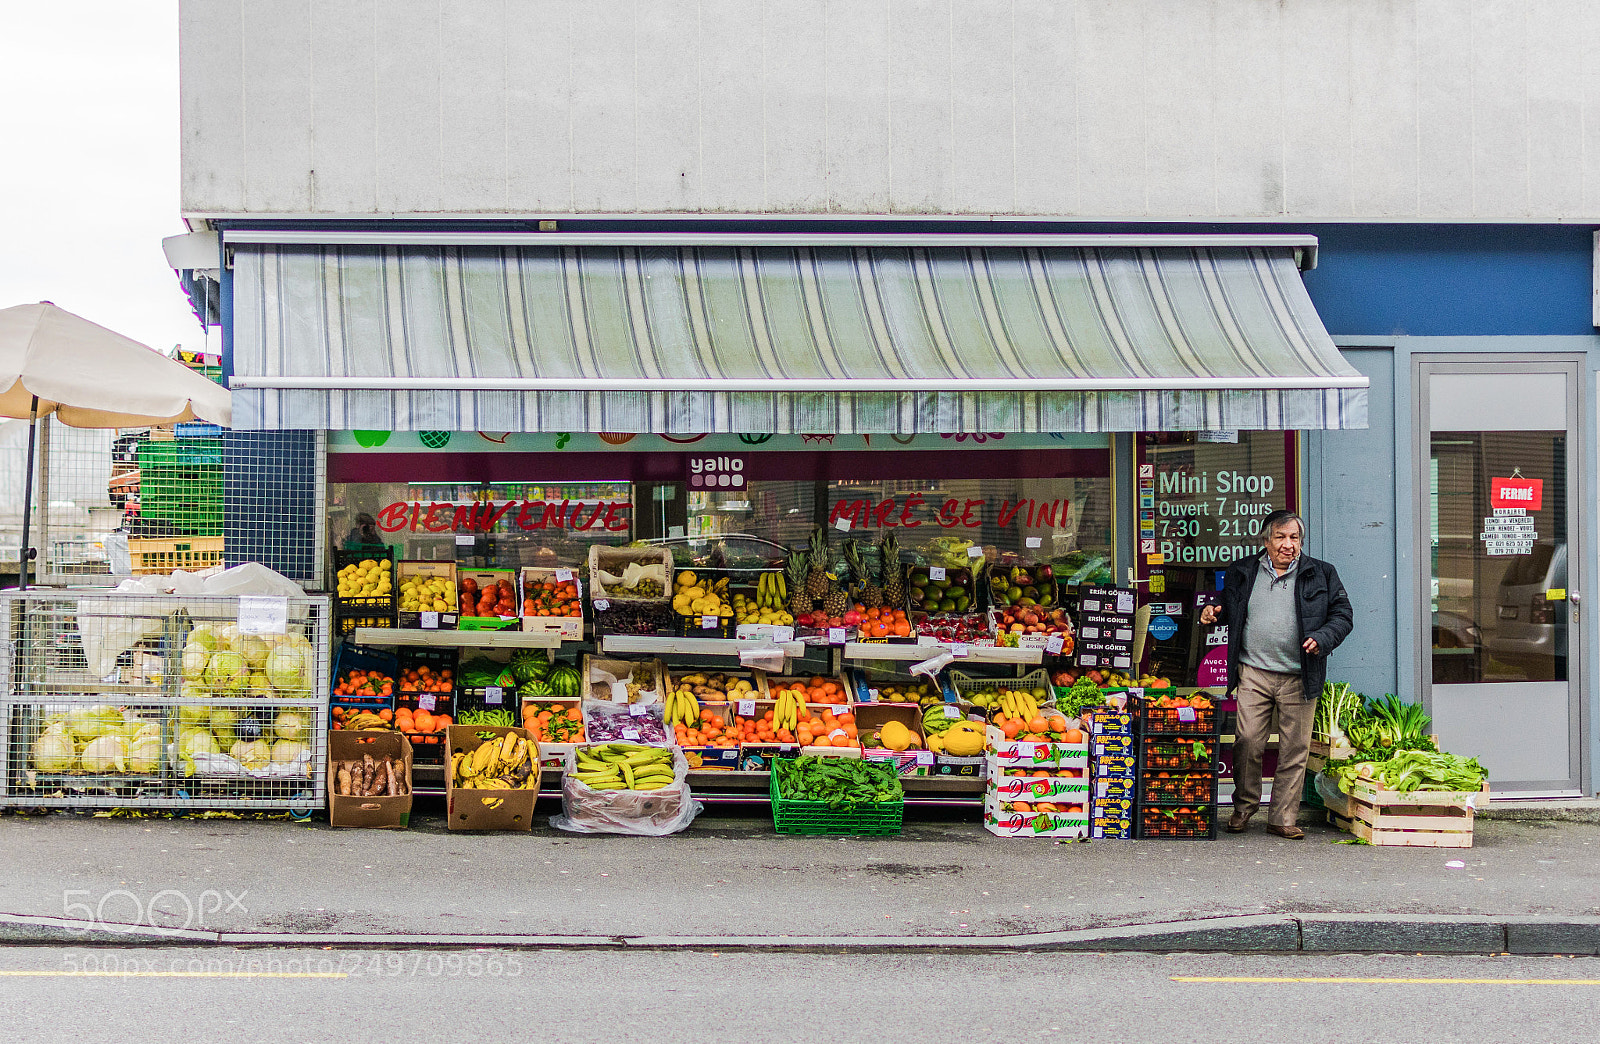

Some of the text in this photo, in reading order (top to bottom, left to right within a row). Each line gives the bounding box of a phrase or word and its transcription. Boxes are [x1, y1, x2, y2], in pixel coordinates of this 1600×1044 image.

[691, 456, 744, 473] yallo
[1160, 470, 1274, 498] Mini Shop
[1500, 487, 1533, 500] FERMÉ
[376, 499, 634, 533] BIENVENUE
[828, 492, 1070, 529] MIRË SE VINI
[1159, 497, 1273, 517] Ouvert 7 Jours
[1160, 519, 1200, 537] 7.30
[1209, 635, 1219, 644] de
